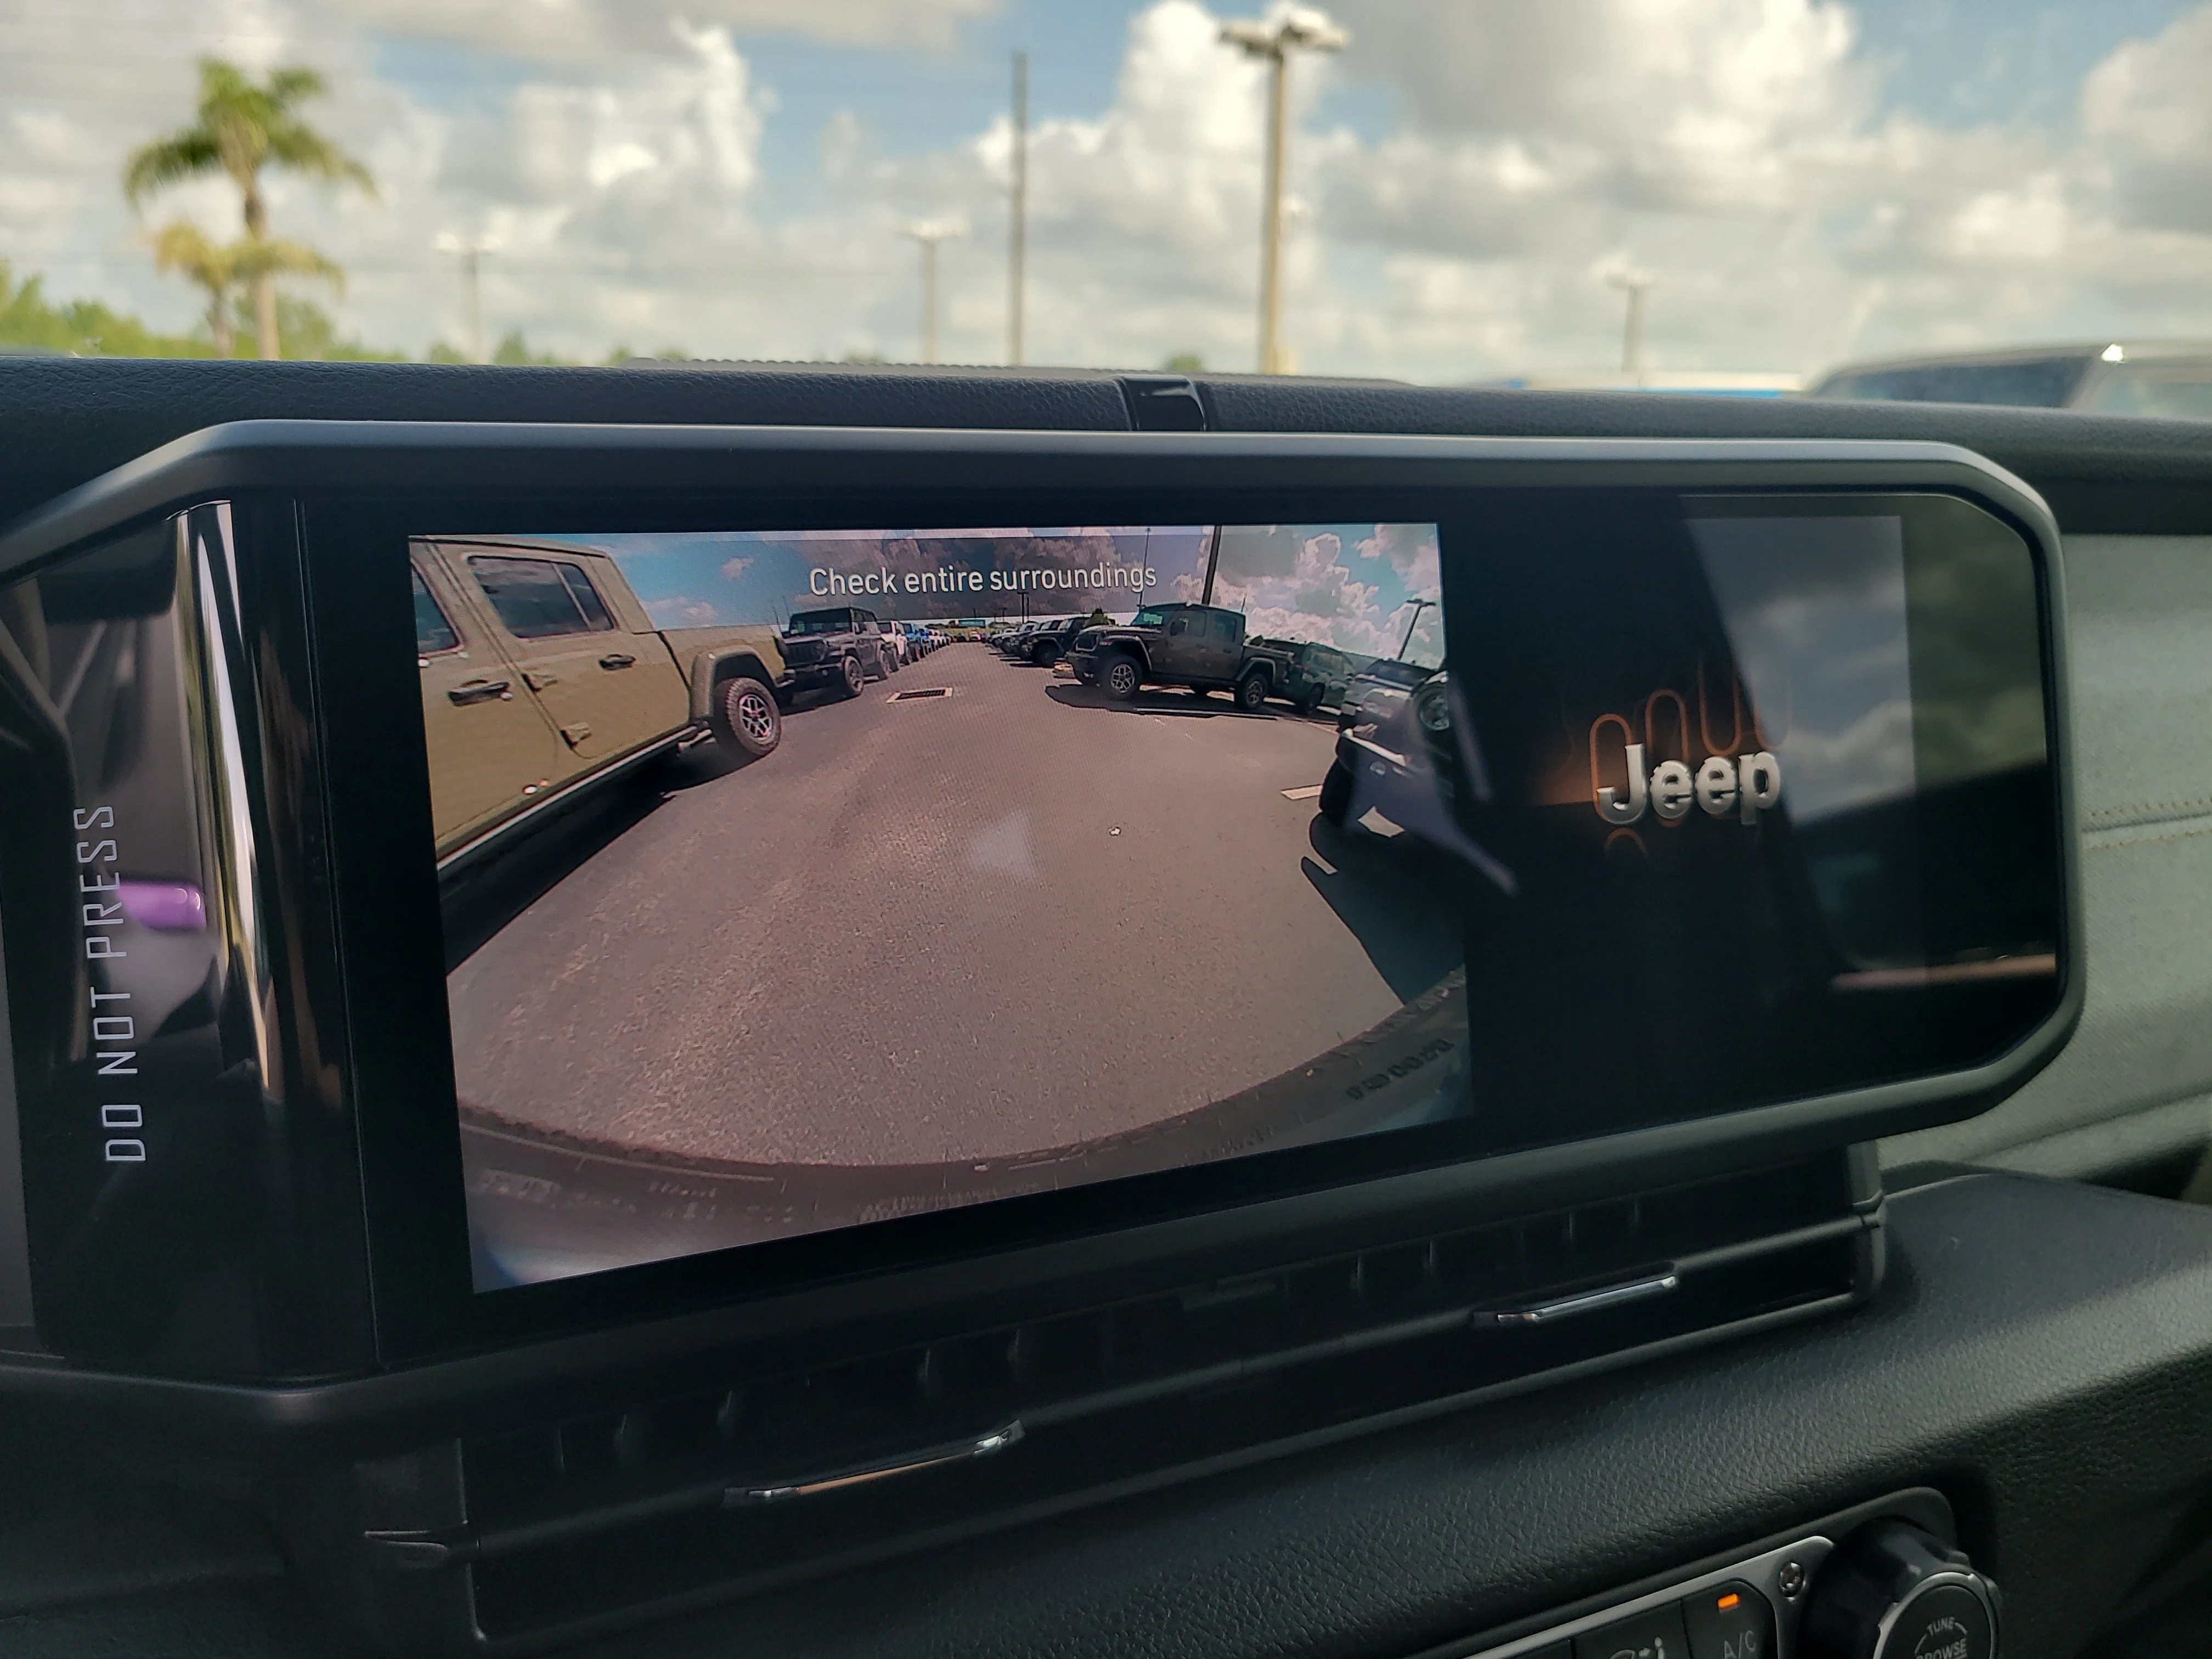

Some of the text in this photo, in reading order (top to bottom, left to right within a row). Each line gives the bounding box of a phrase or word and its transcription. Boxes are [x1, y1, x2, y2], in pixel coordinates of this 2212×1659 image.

[810, 561, 1157, 595] Check entire surroundings
[1596, 743, 1781, 825] Jeep
[73, 805, 146, 1161] DO NOT PRESS
[1926, 1616, 1955, 1637] TUNE
[1724, 1629, 1756, 1659] A/C
